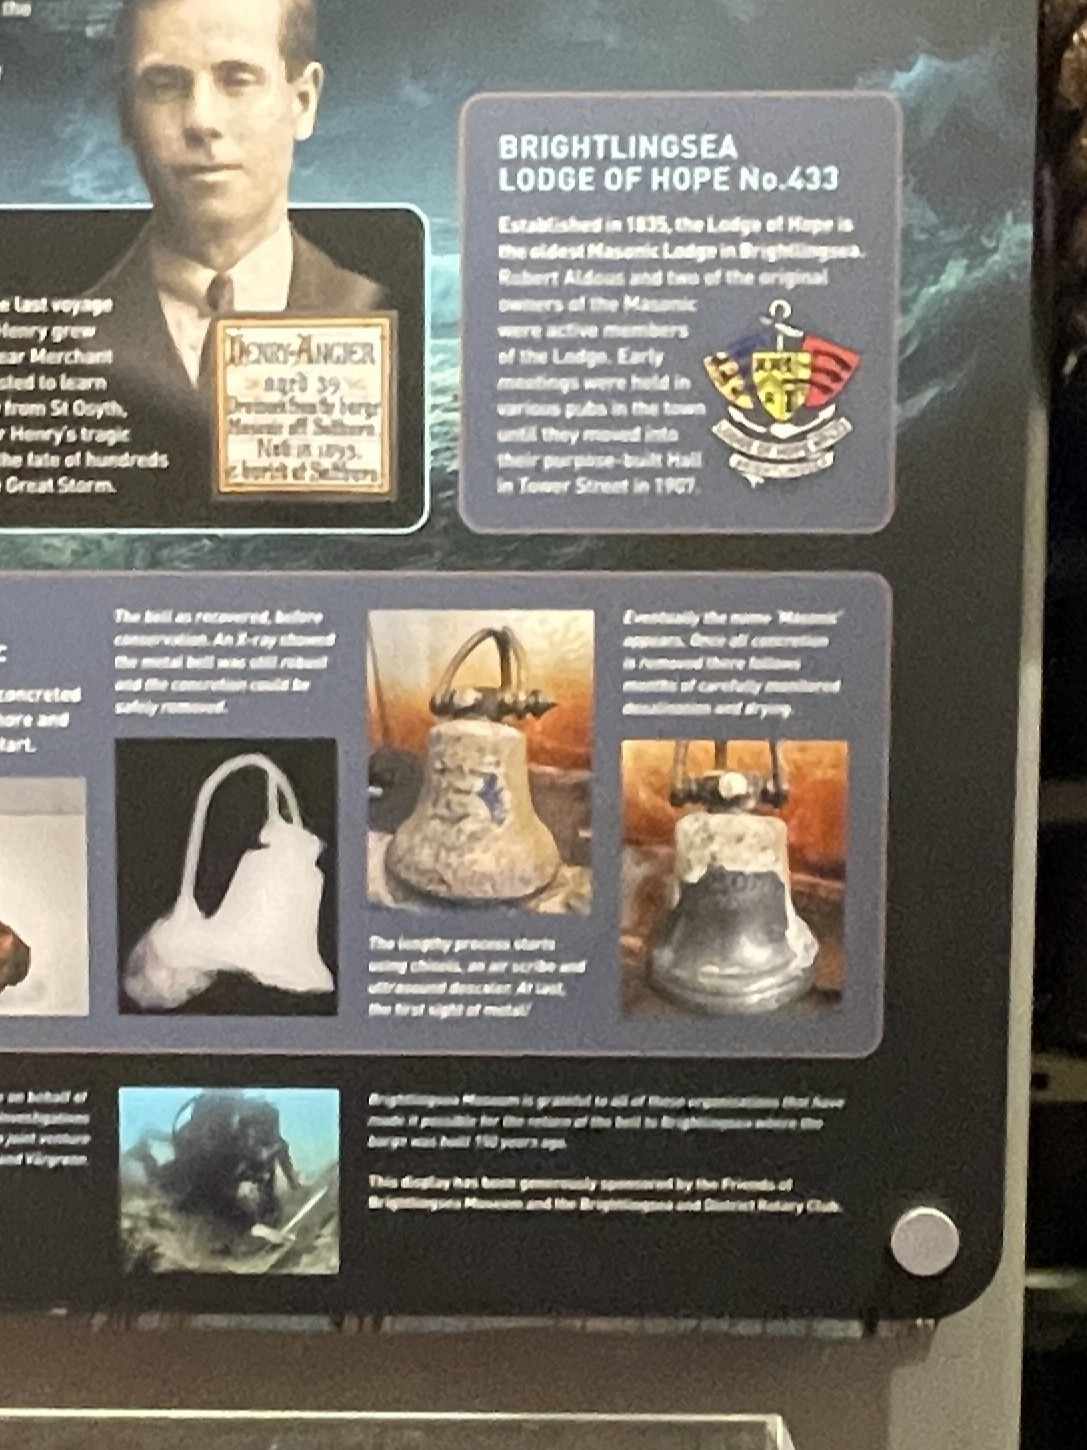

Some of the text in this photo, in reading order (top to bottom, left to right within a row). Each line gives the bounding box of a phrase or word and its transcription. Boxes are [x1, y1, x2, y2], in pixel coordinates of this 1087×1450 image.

[499, 133, 737, 158] BRIGHTLINGSEA
[499, 166, 838, 191] LODGE OF HOPE No.433
